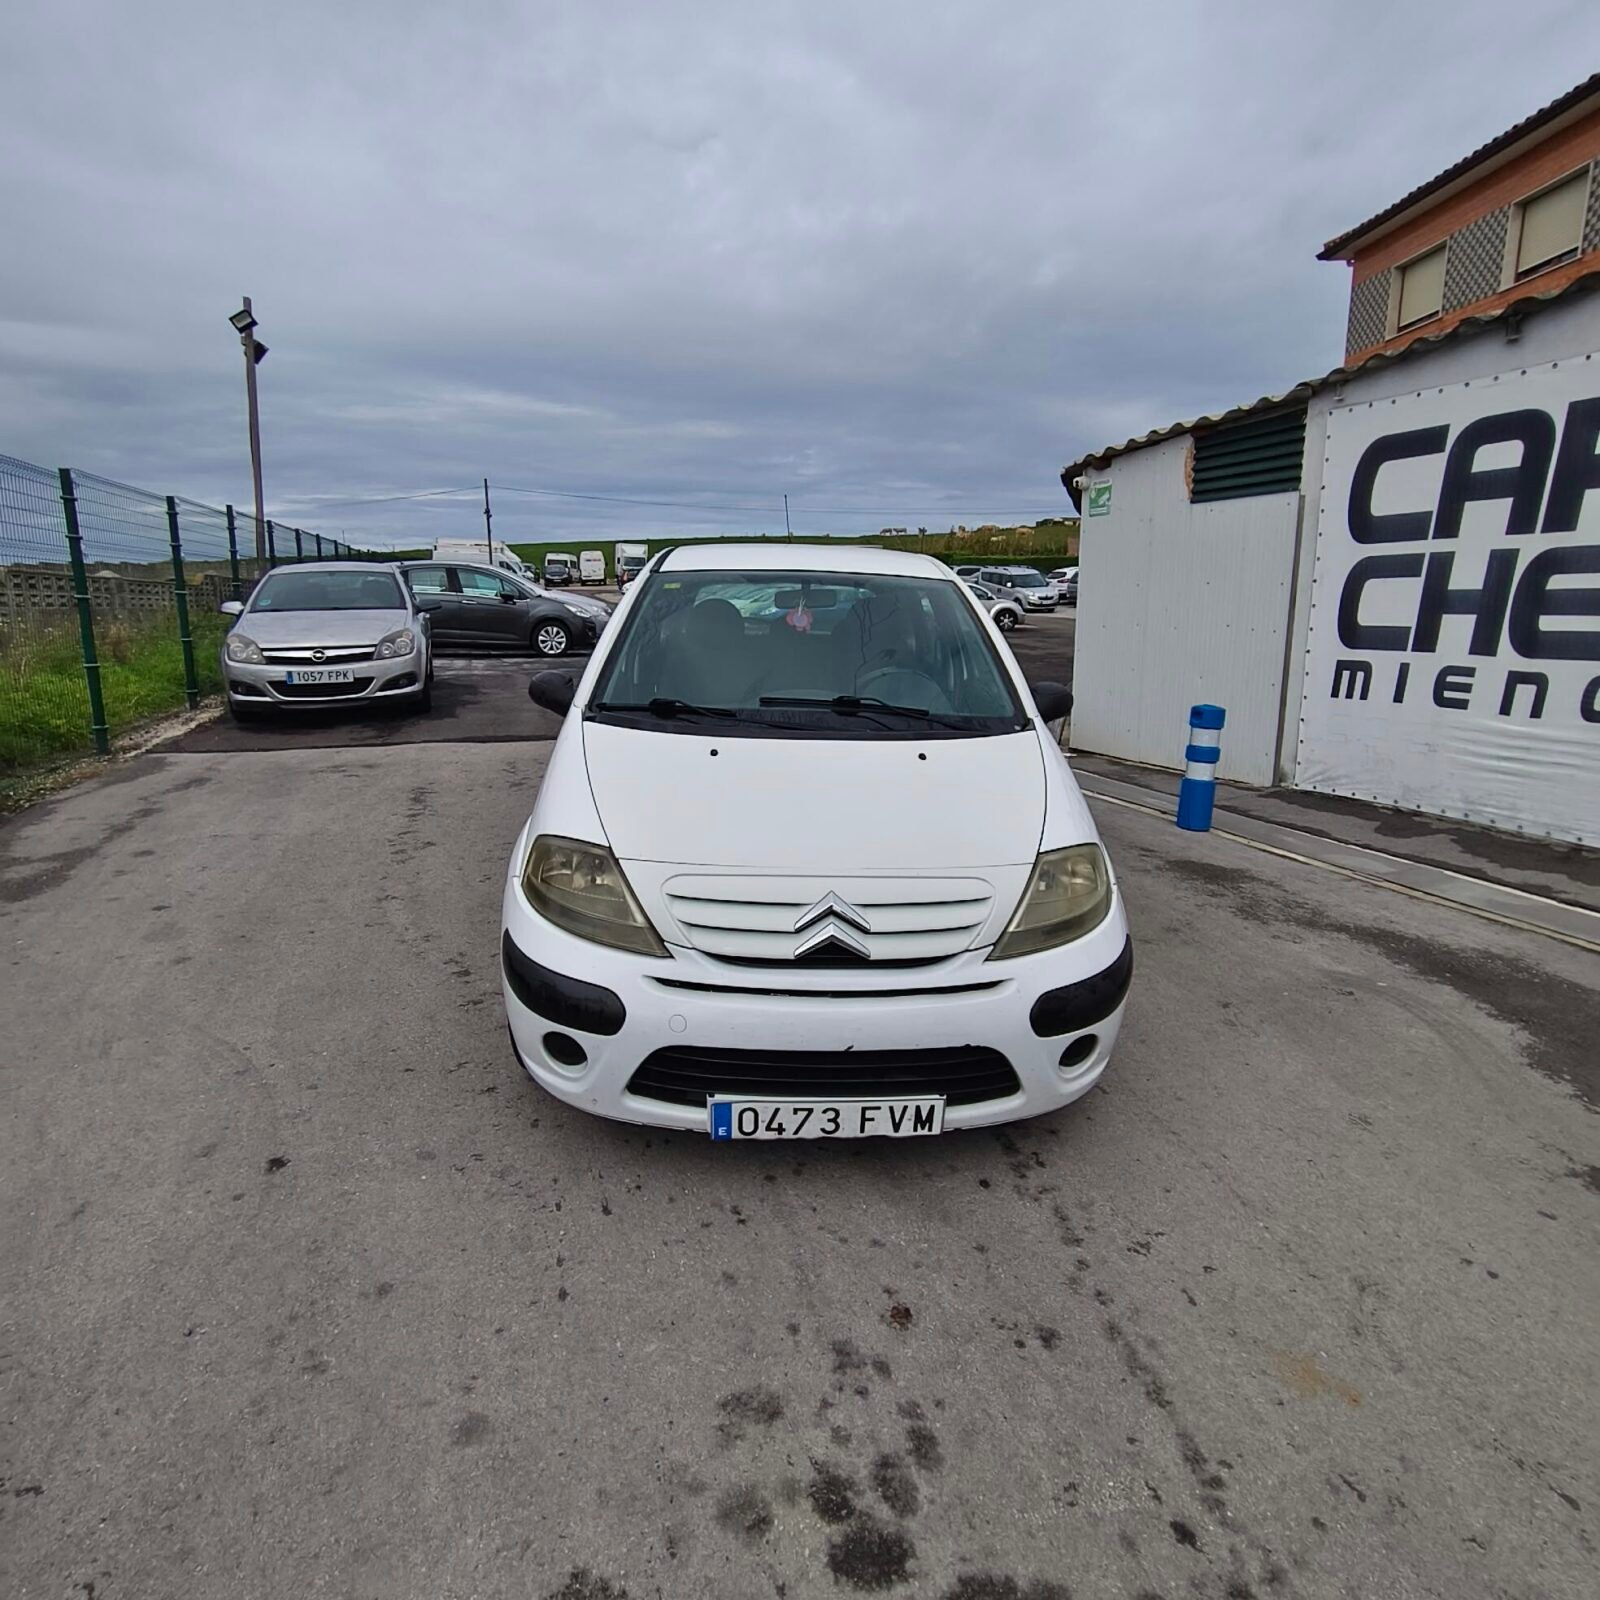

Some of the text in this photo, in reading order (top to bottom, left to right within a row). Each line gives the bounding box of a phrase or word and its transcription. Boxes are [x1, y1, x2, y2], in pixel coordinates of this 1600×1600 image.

[1337, 544, 1600, 661] CHE
[297, 670, 350, 682] 1057 FPK
[718, 1127, 727, 1136] E
[737, 1104, 936, 1137] 0473 FVM
